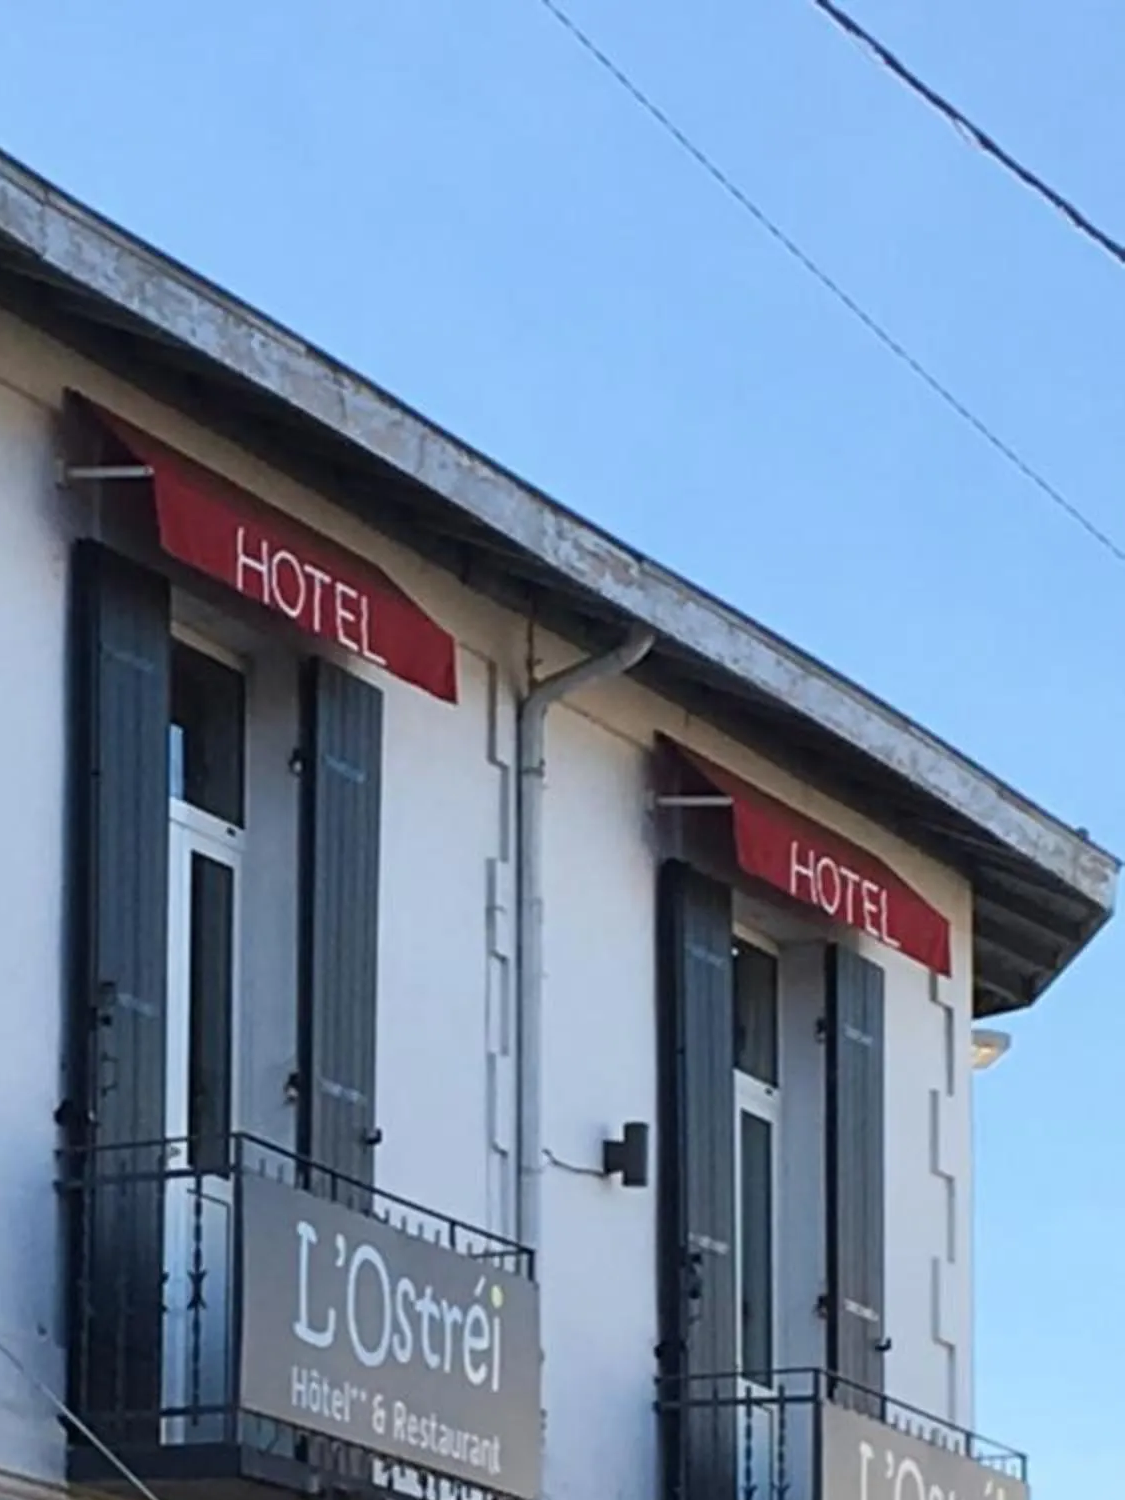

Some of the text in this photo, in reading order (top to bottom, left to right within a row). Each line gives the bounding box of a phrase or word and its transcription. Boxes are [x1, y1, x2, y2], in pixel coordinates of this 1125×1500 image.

[236, 527, 387, 665] HOTEL
[790, 841, 900, 947] HOTEL
[293, 1220, 504, 1393] L'Ostréi
[372, 1394, 386, 1434] &
[393, 1400, 502, 1475] Restaurant
